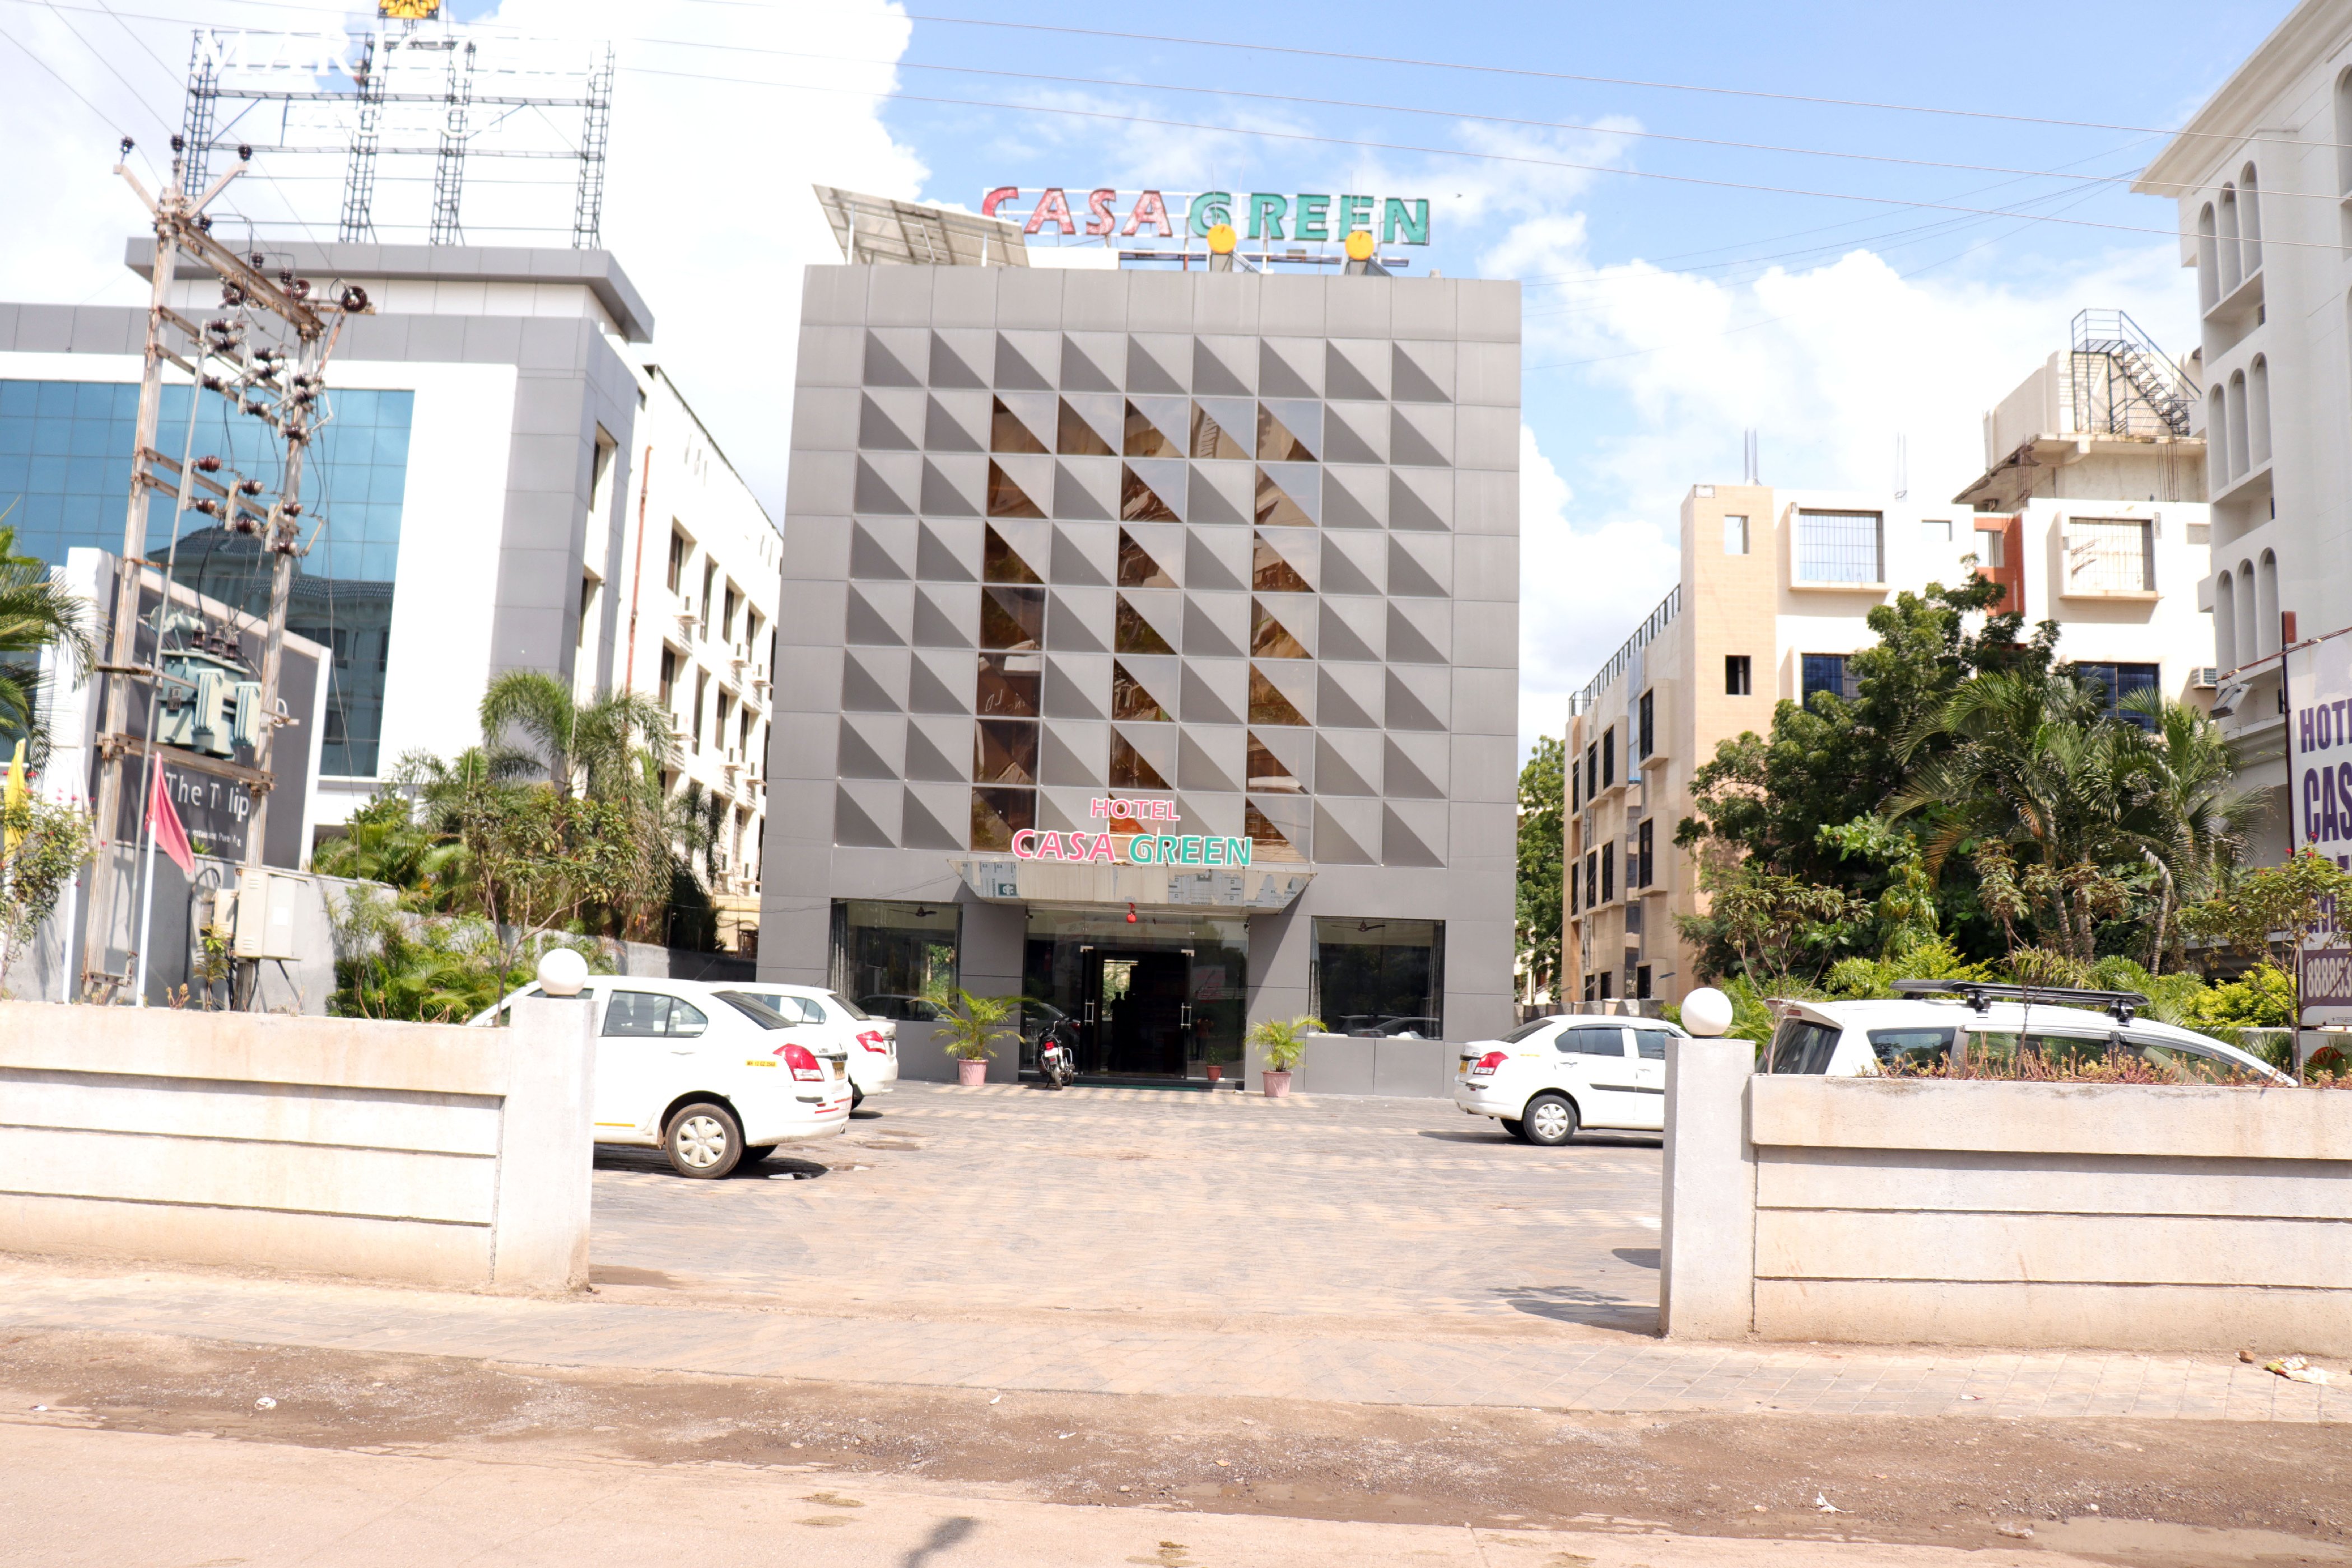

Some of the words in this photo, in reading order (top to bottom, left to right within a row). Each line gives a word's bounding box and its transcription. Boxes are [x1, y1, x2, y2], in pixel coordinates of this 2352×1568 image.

[981, 186, 1172, 237] CASA
[1189, 191, 1429, 245] GREEN
[166, 772, 202, 806] The
[210, 782, 249, 822] Tlip
[1090, 797, 1180, 821] HOTEL
[1012, 828, 1116, 862] CASA
[1128, 833, 1252, 866] GREEN
